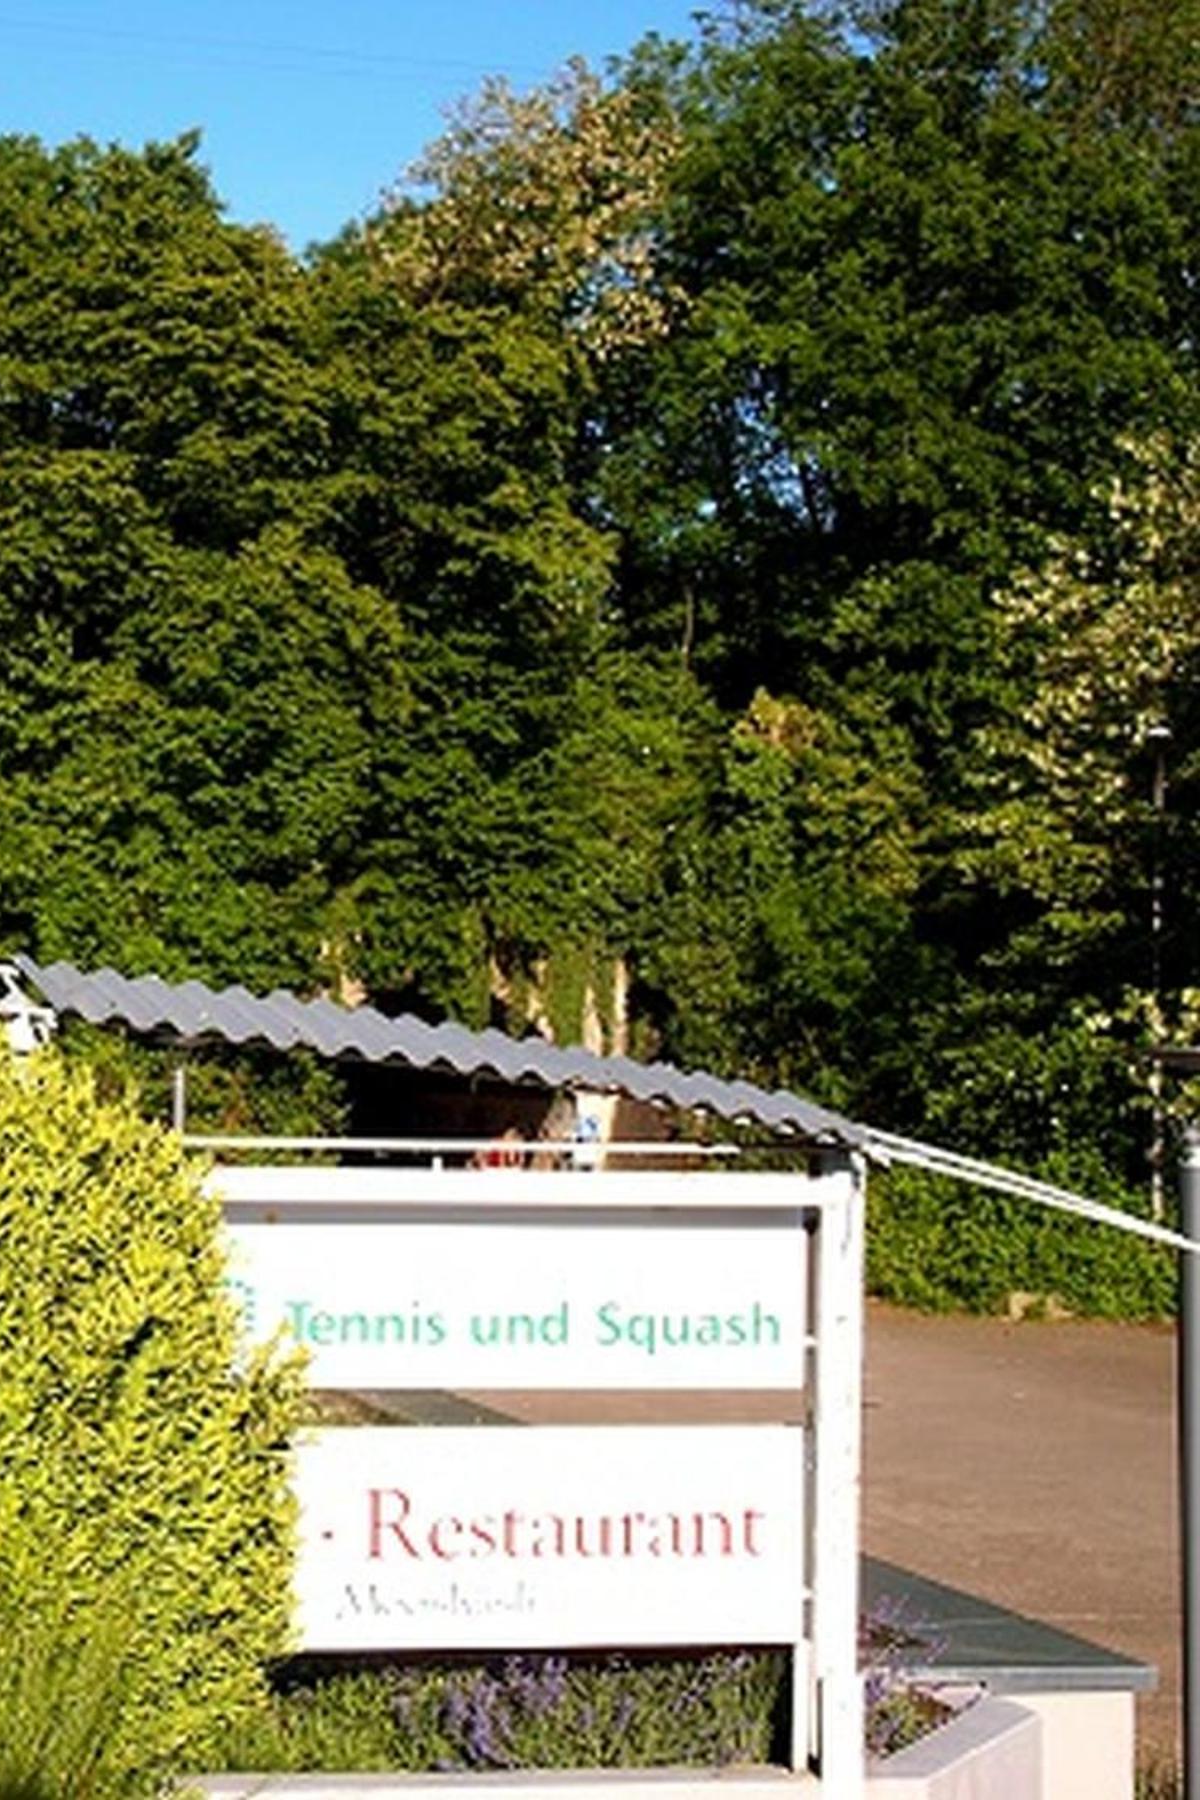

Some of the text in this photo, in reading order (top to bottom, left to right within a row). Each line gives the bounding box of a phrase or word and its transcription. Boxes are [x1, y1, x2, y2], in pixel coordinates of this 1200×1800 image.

[284, 1299, 780, 1356] Tennis und Squash
[366, 1487, 765, 1562] Restaurant
